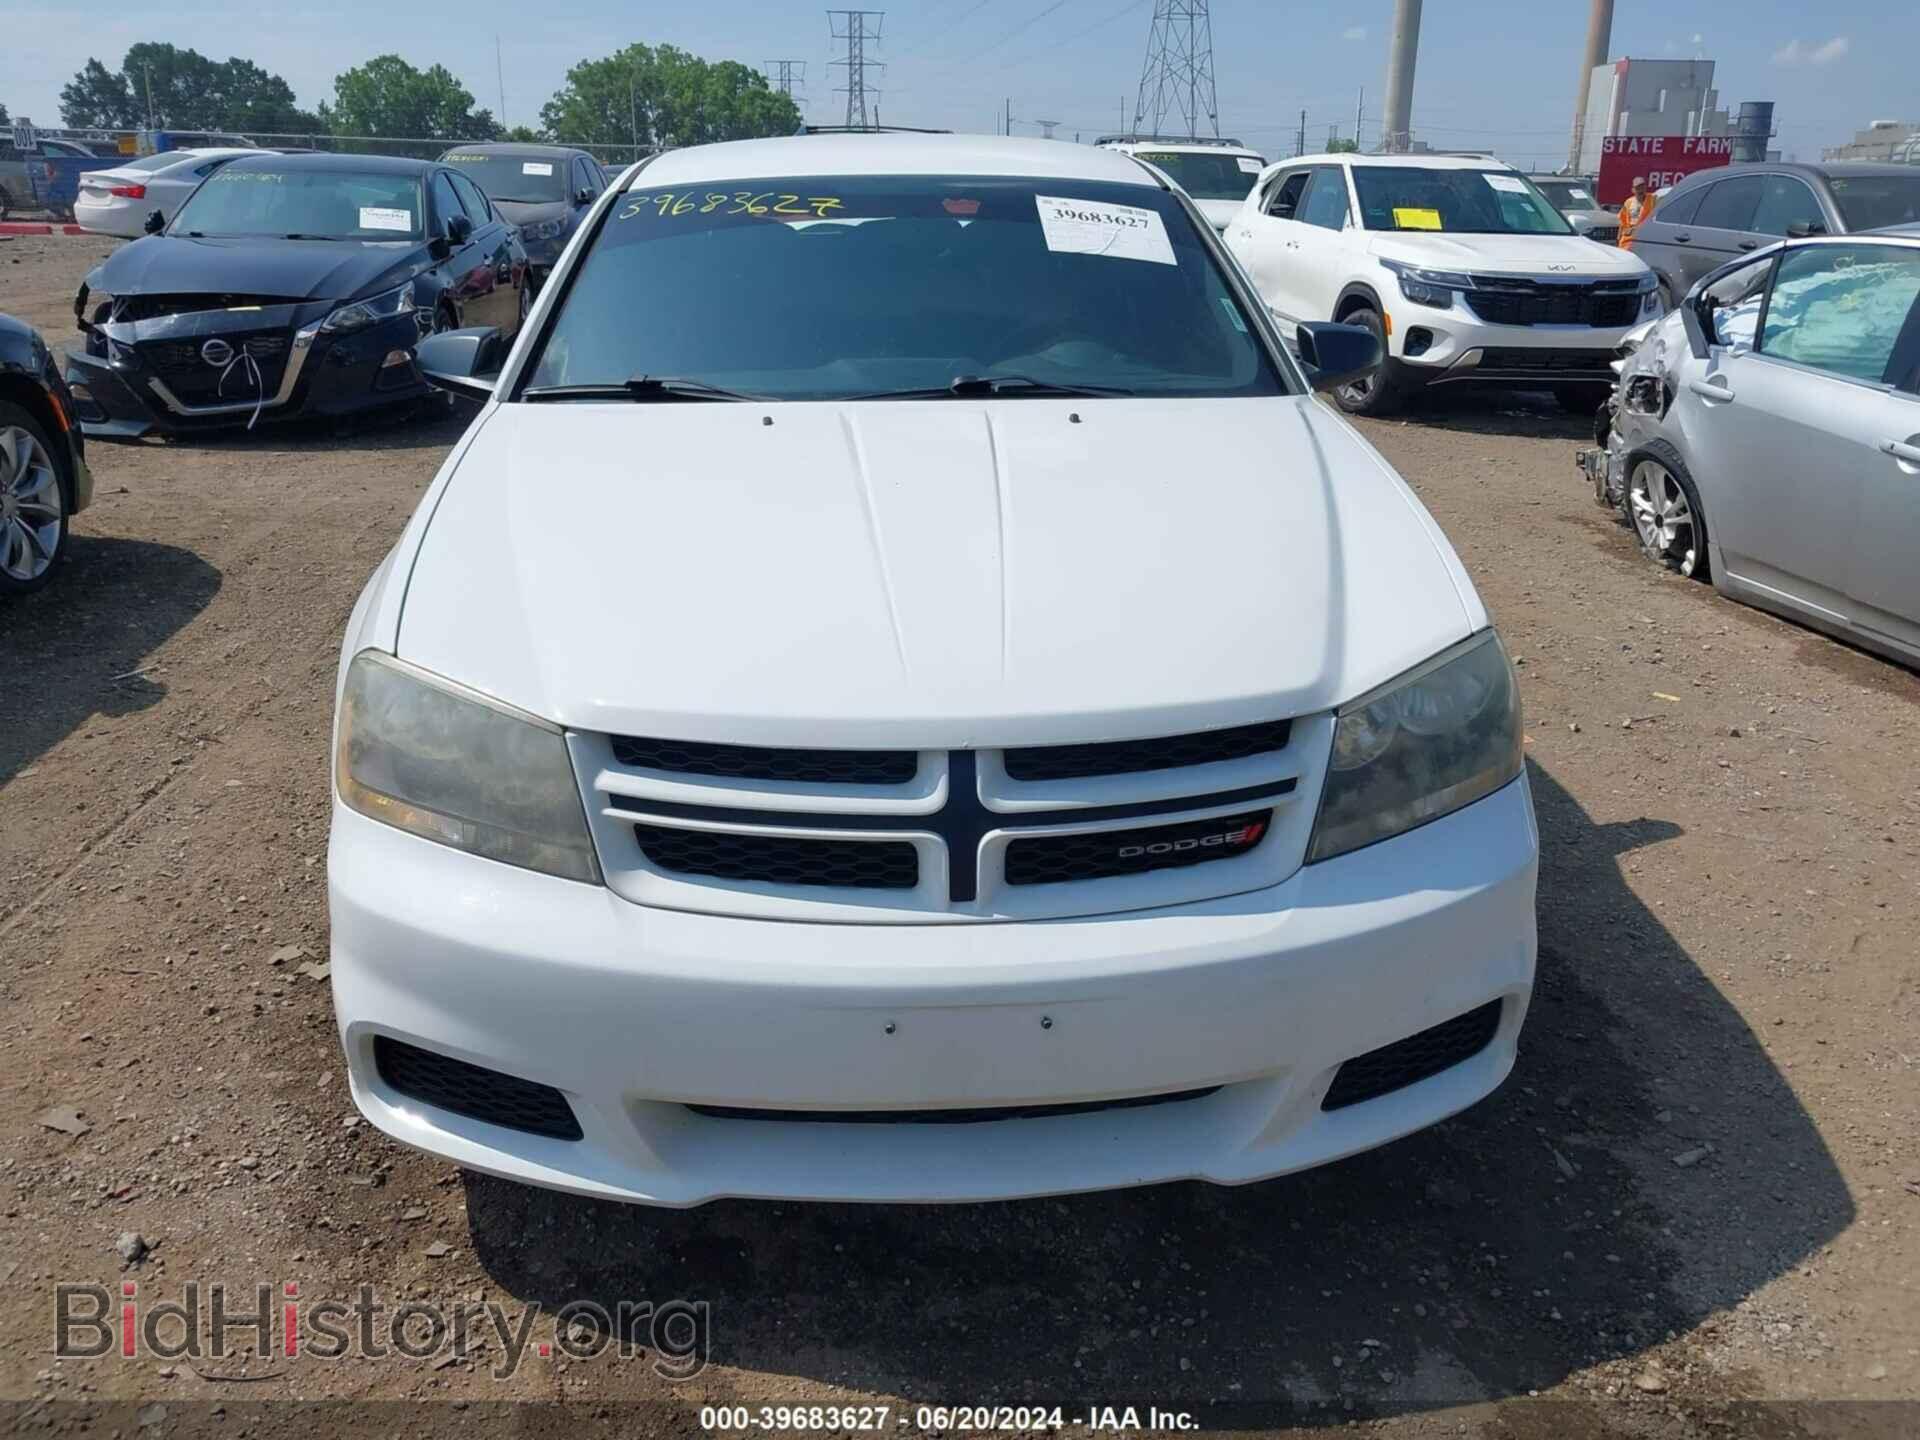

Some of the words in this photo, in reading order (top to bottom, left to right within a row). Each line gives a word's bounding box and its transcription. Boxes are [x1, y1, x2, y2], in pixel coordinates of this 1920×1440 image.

[1603, 138, 1665, 153] STATE
[1683, 138, 1731, 154] FARM
[619, 192, 844, 219] 39683627
[1053, 208, 1149, 229] 39683627
[1119, 829, 1247, 857] DODGE
